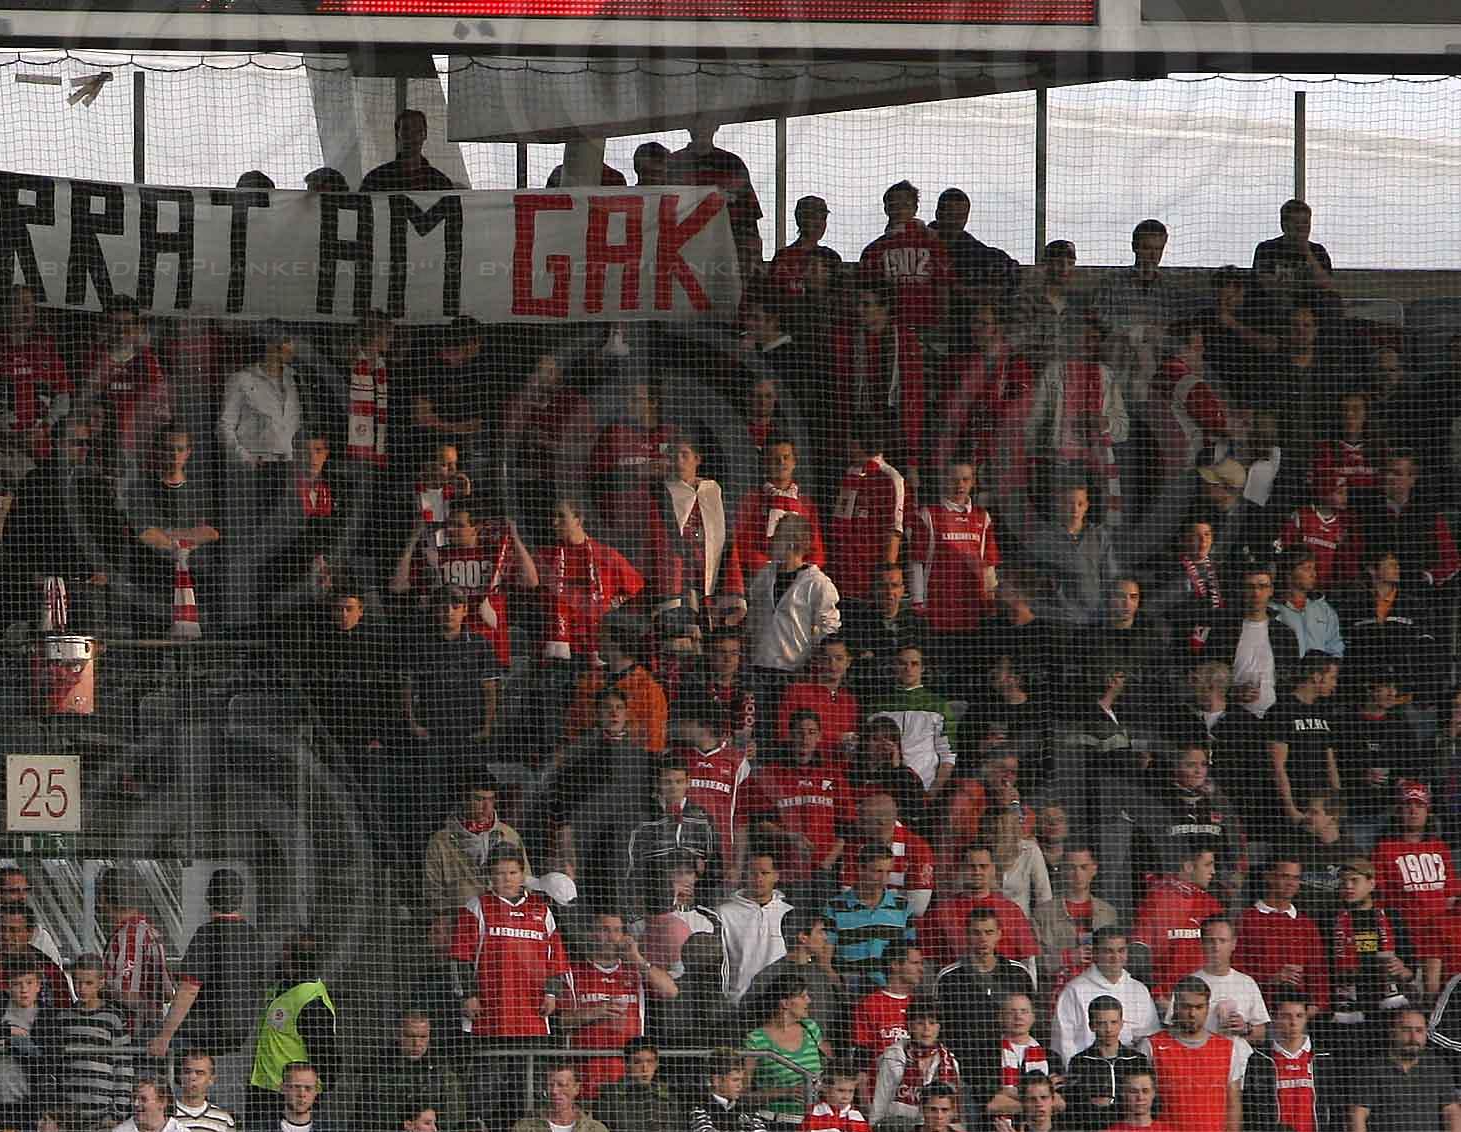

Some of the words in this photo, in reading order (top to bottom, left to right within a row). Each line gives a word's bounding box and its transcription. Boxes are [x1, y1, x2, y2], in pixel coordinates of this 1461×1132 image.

[316, 191, 463, 318] AM
[511, 191, 728, 317] GAK
[19, 767, 68, 817] 25
[1395, 853, 1445, 884] 1902
